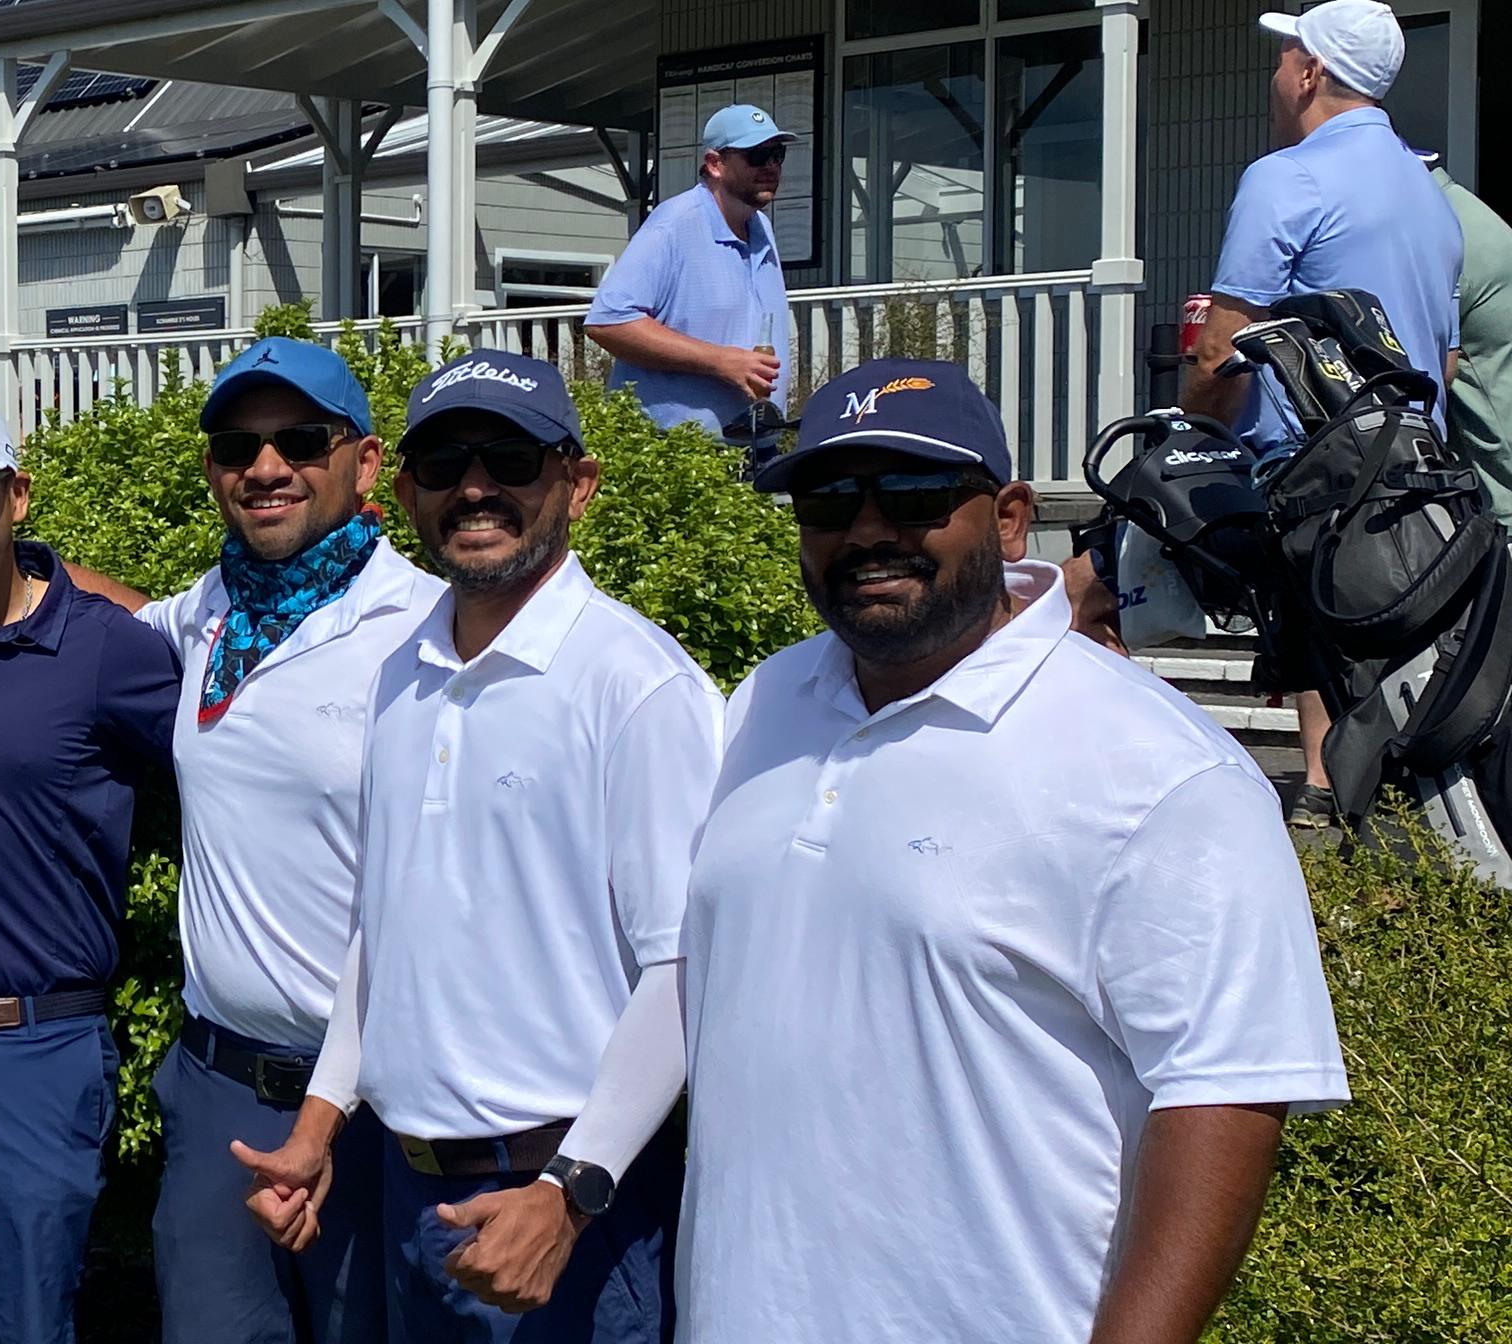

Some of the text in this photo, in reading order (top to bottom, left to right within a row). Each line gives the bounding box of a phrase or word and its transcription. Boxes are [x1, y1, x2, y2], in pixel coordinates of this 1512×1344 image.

[68, 314, 101, 325] WARNING
[422, 360, 538, 403] Titleist
[840, 388, 879, 420] M
[1165, 449, 1241, 465] clicgear
